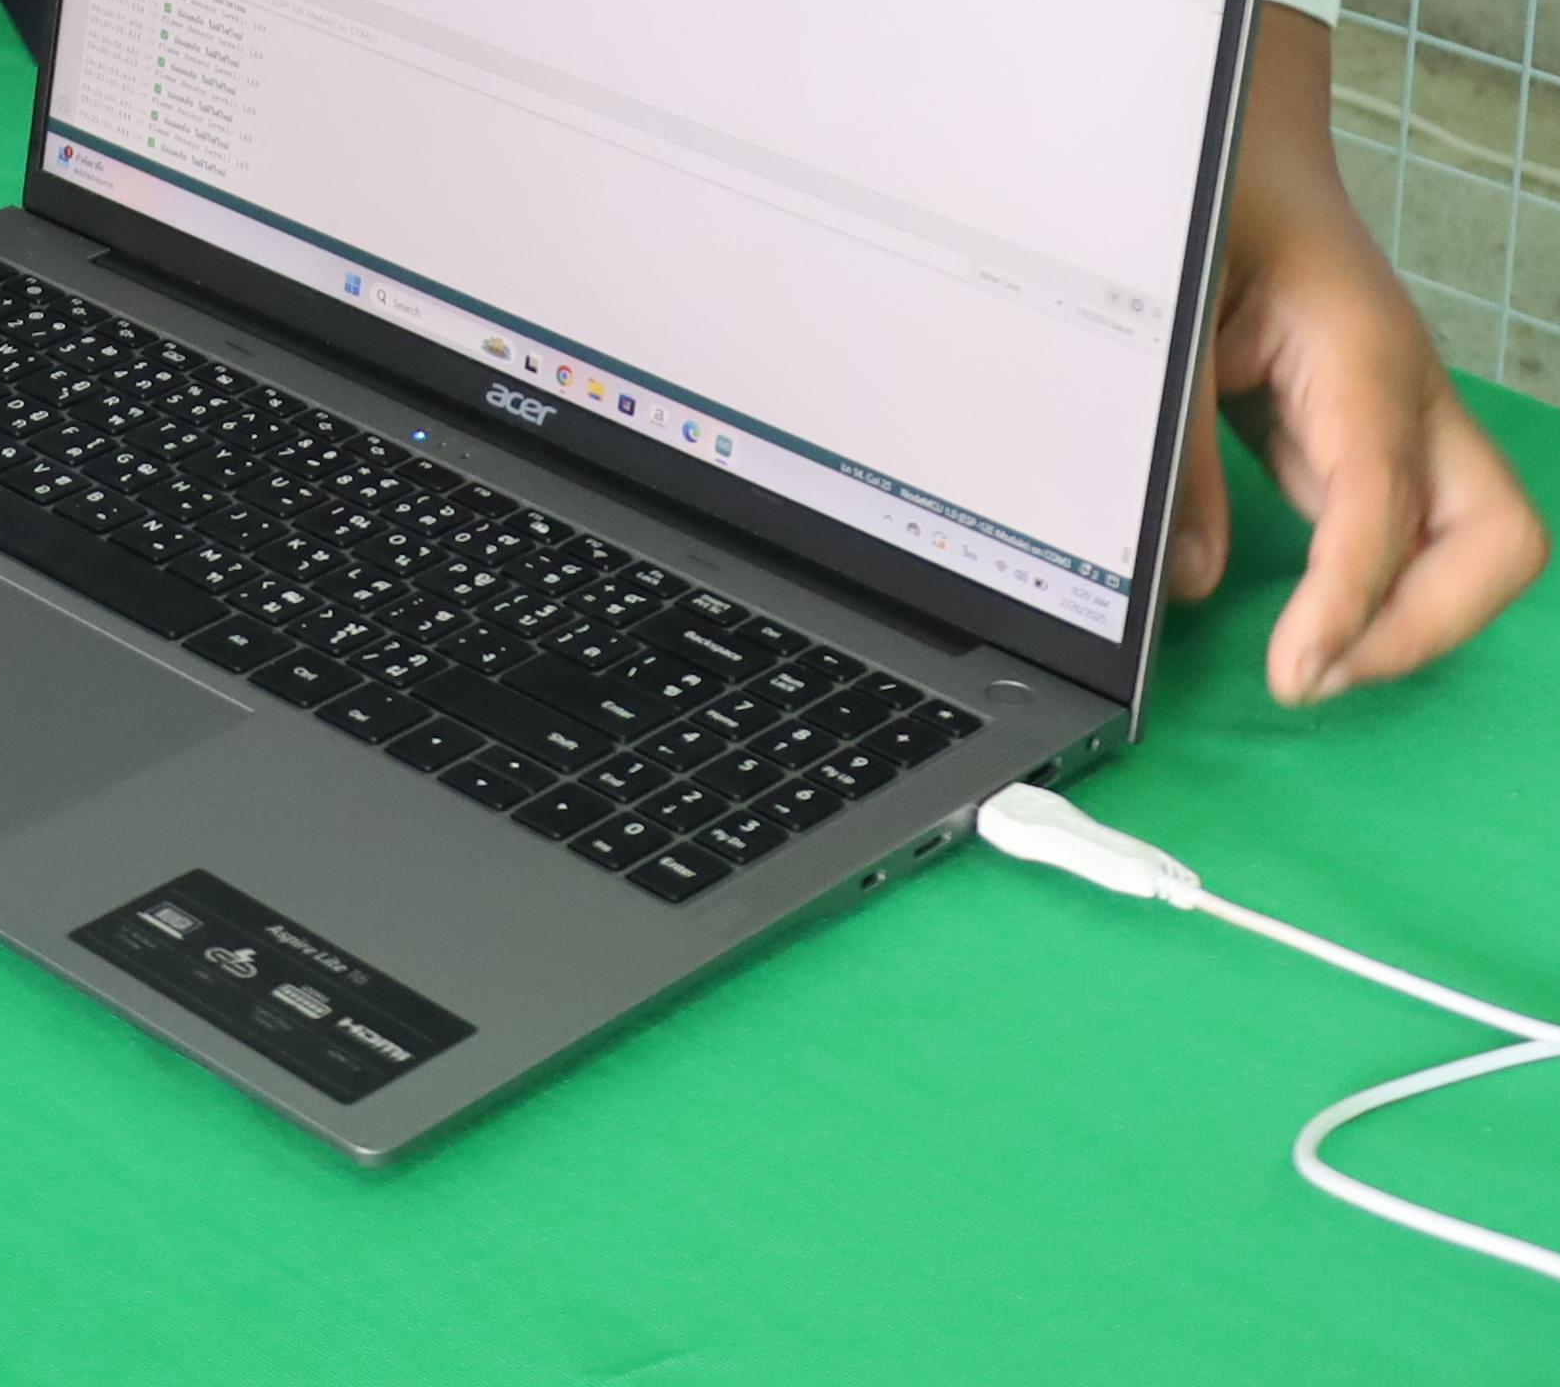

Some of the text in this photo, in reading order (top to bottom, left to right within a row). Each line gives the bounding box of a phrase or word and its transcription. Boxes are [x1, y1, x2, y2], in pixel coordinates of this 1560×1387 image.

[485, 382, 557, 427] acer
[683, 629, 744, 662] Backspace
[600, 700, 636, 721] Enter
[547, 731, 579, 752] Shift
[659, 856, 697, 878] Enter
[264, 924, 318, 955] Aspire
[336, 1016, 417, 1062] HDMI
